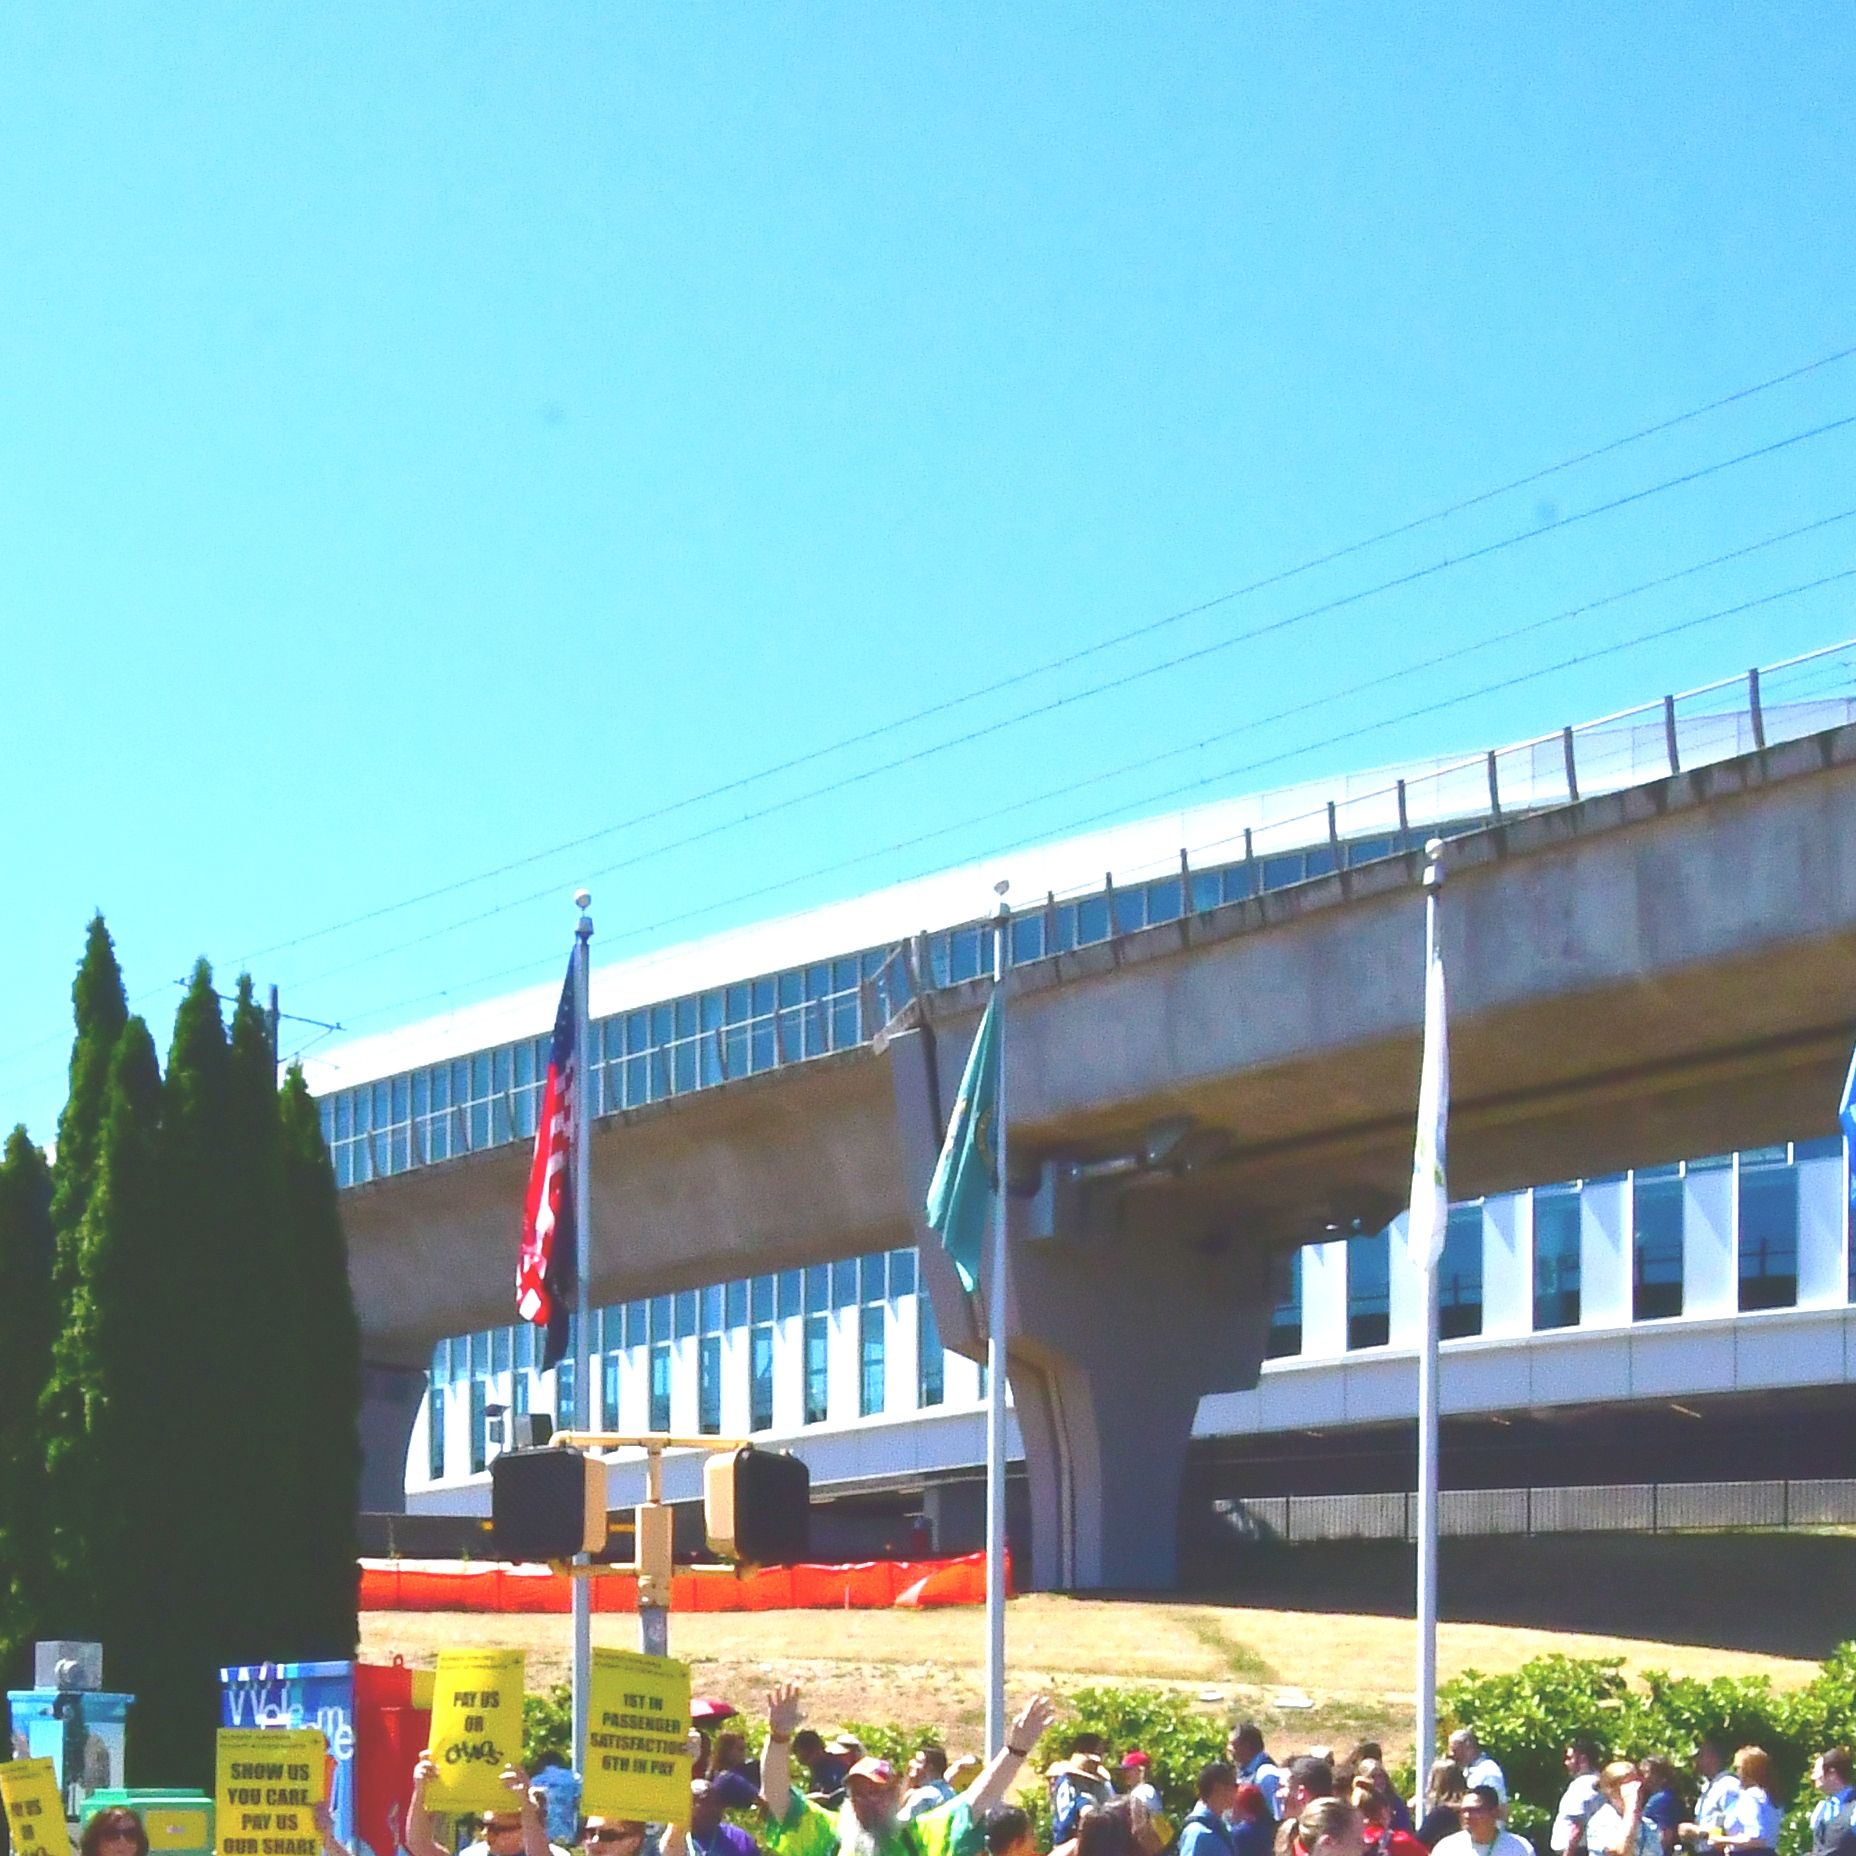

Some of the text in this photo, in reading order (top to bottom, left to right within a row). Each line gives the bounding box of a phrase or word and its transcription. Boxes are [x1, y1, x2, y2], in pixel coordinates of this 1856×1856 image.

[454, 1690, 500, 1708] PAY US
[623, 1693, 664, 1711] 1ST IN
[464, 1715, 485, 1733] OR
[602, 1711, 682, 1734] PASSENGER
[445, 1740, 504, 1766] CHAOS
[231, 1763, 310, 1781] SHOW US
[632, 1758, 648, 1774] IN
[650, 1760, 676, 1777] PAY
[227, 1788, 309, 1806] YOU CARE
[241, 1813, 299, 1831] PAY US
[223, 1837, 316, 1856] OUR SHARE
